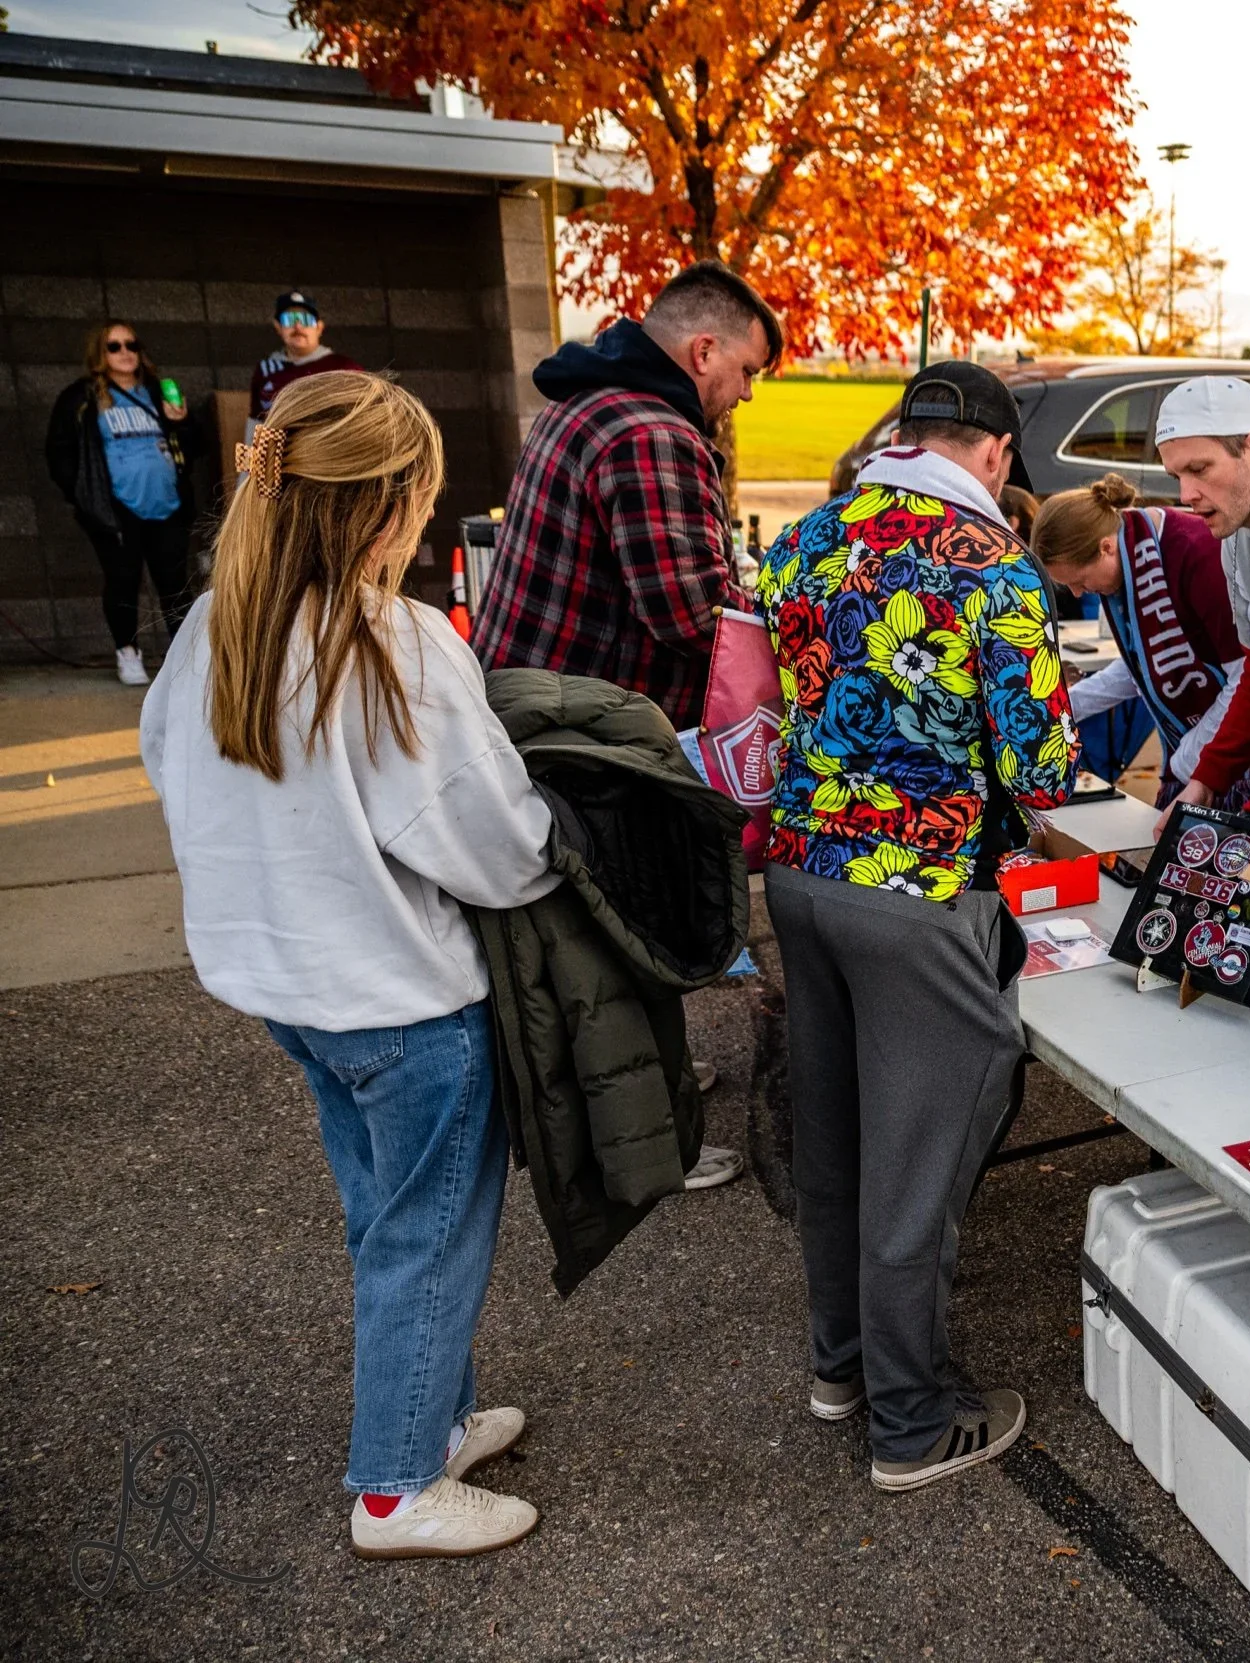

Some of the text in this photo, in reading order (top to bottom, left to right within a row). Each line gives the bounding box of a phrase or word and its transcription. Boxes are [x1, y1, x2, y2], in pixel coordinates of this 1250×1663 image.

[1133, 537, 1208, 699] RAPIDS
[1182, 846, 1204, 861] 38
[1163, 865, 1234, 901] 19 96
